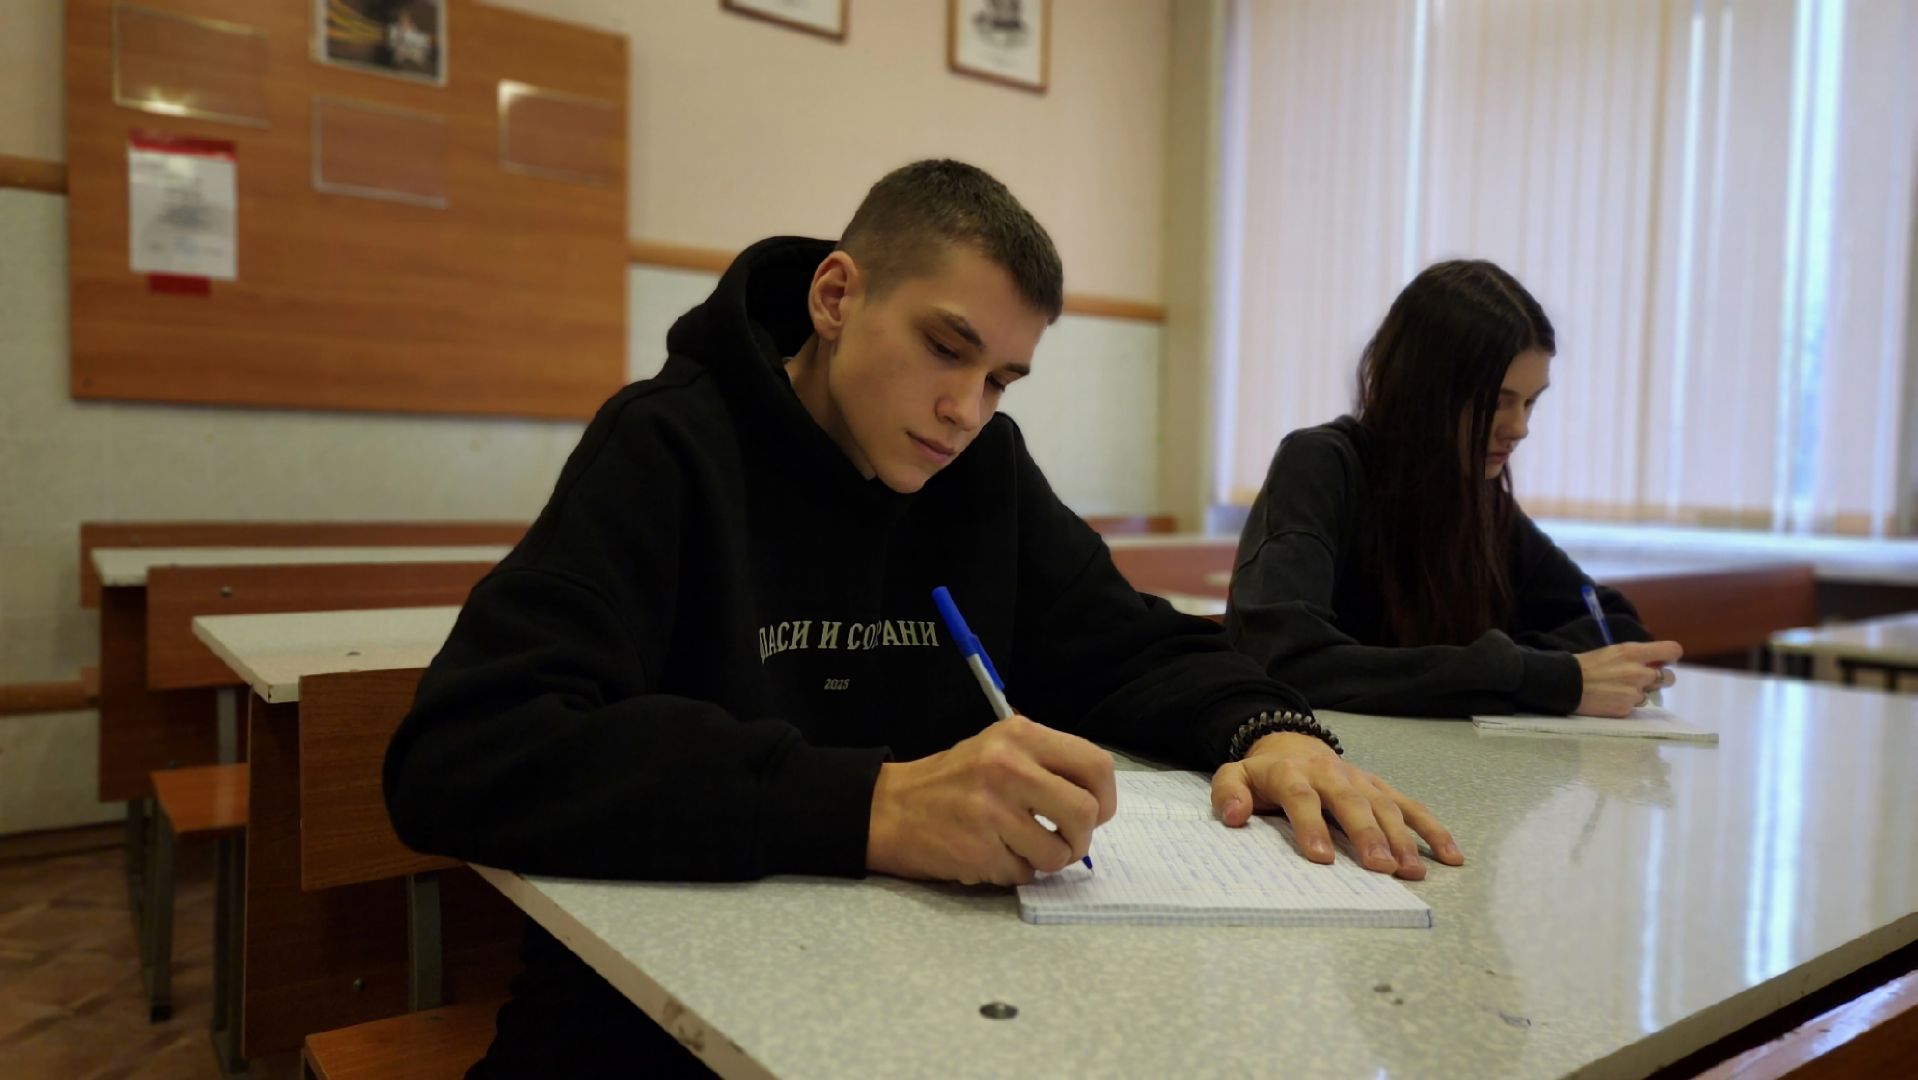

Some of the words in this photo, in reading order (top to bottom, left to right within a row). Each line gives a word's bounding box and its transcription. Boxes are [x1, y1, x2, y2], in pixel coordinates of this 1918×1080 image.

[759, 620, 813, 664] ПАСИ
[818, 620, 842, 649] И
[847, 619, 940, 650] СОРАНИ
[824, 678, 850, 690] 2025
